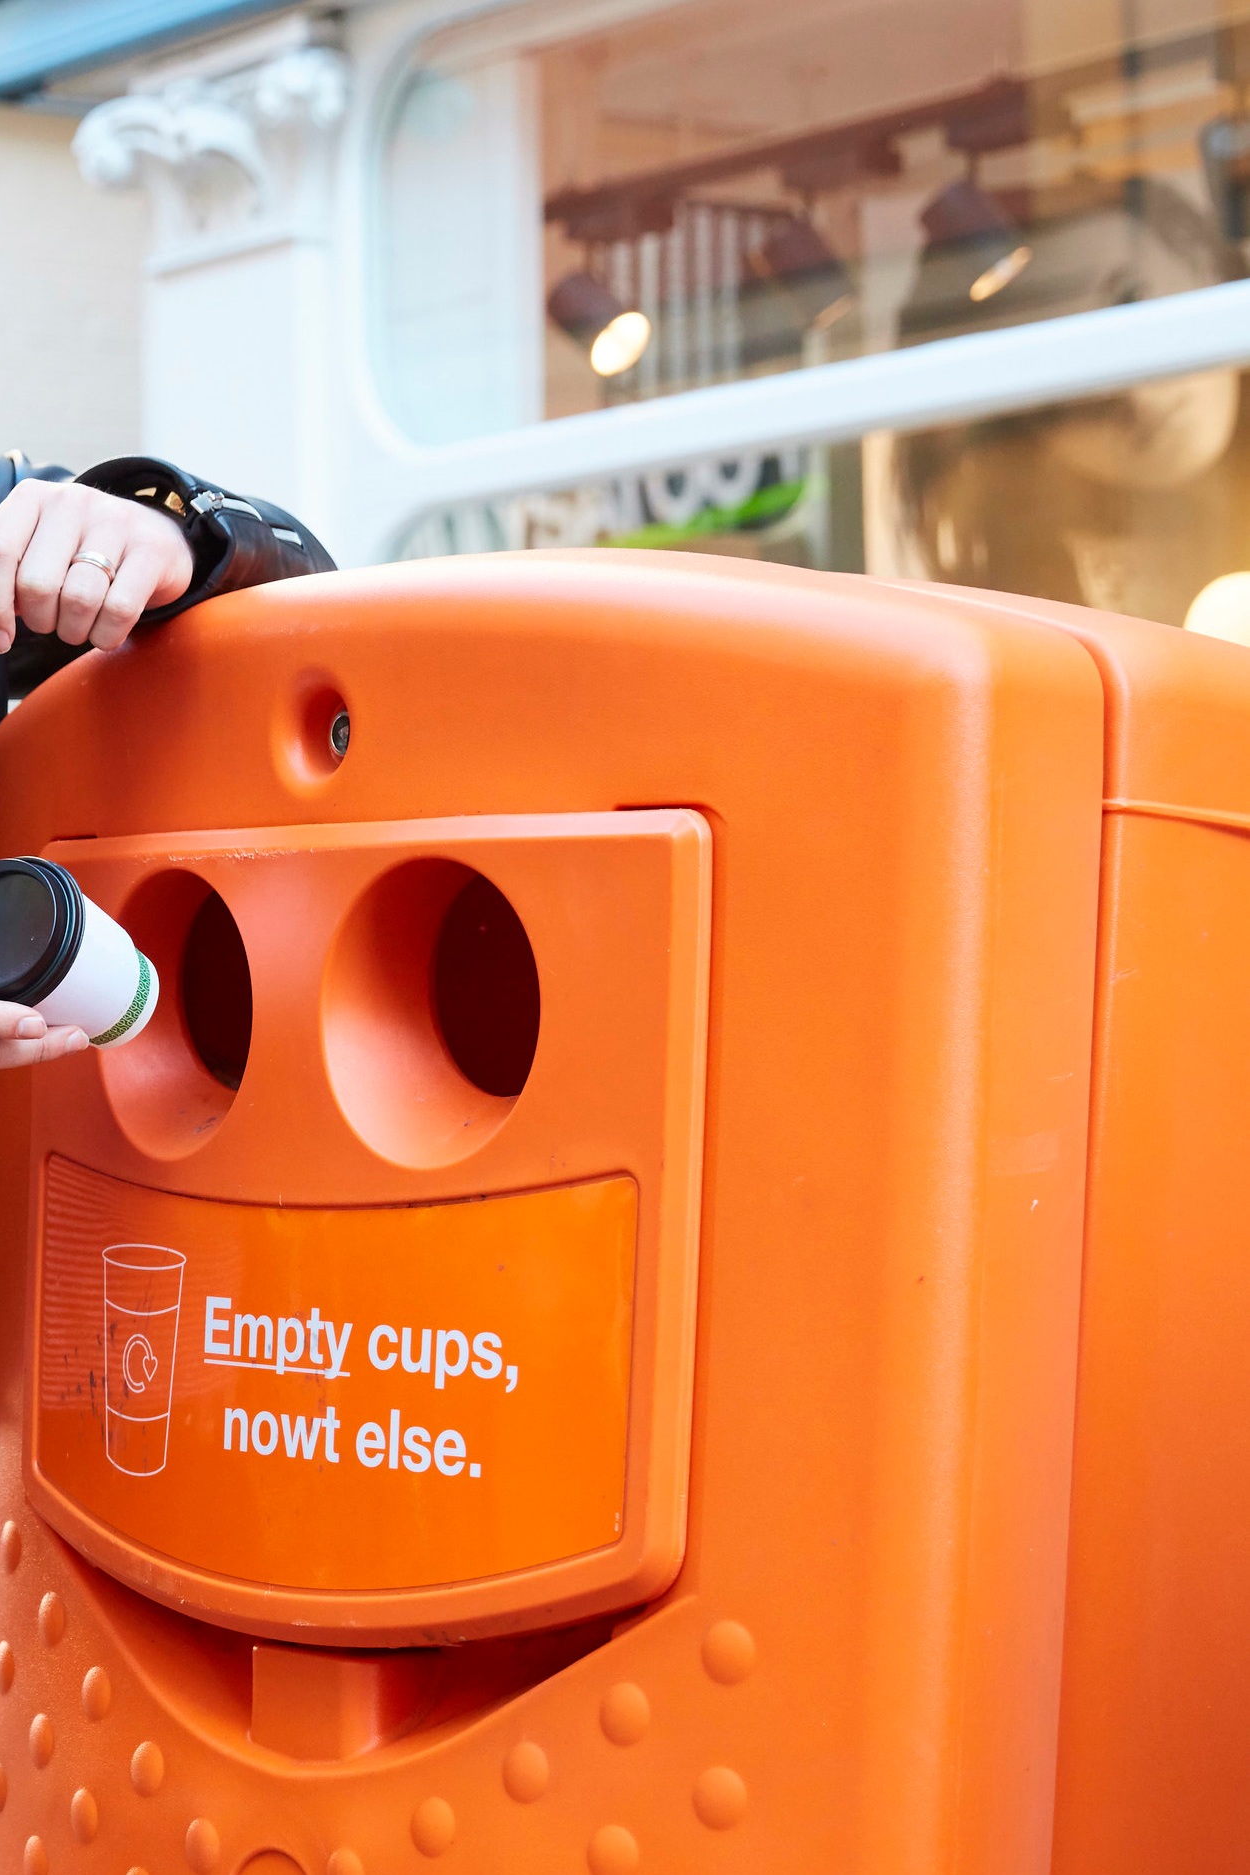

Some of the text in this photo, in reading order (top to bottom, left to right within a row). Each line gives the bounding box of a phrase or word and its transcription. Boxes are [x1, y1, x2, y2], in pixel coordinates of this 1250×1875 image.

[204, 1296, 519, 1393] Empty cups,
[223, 1406, 482, 1478] nowt else.
